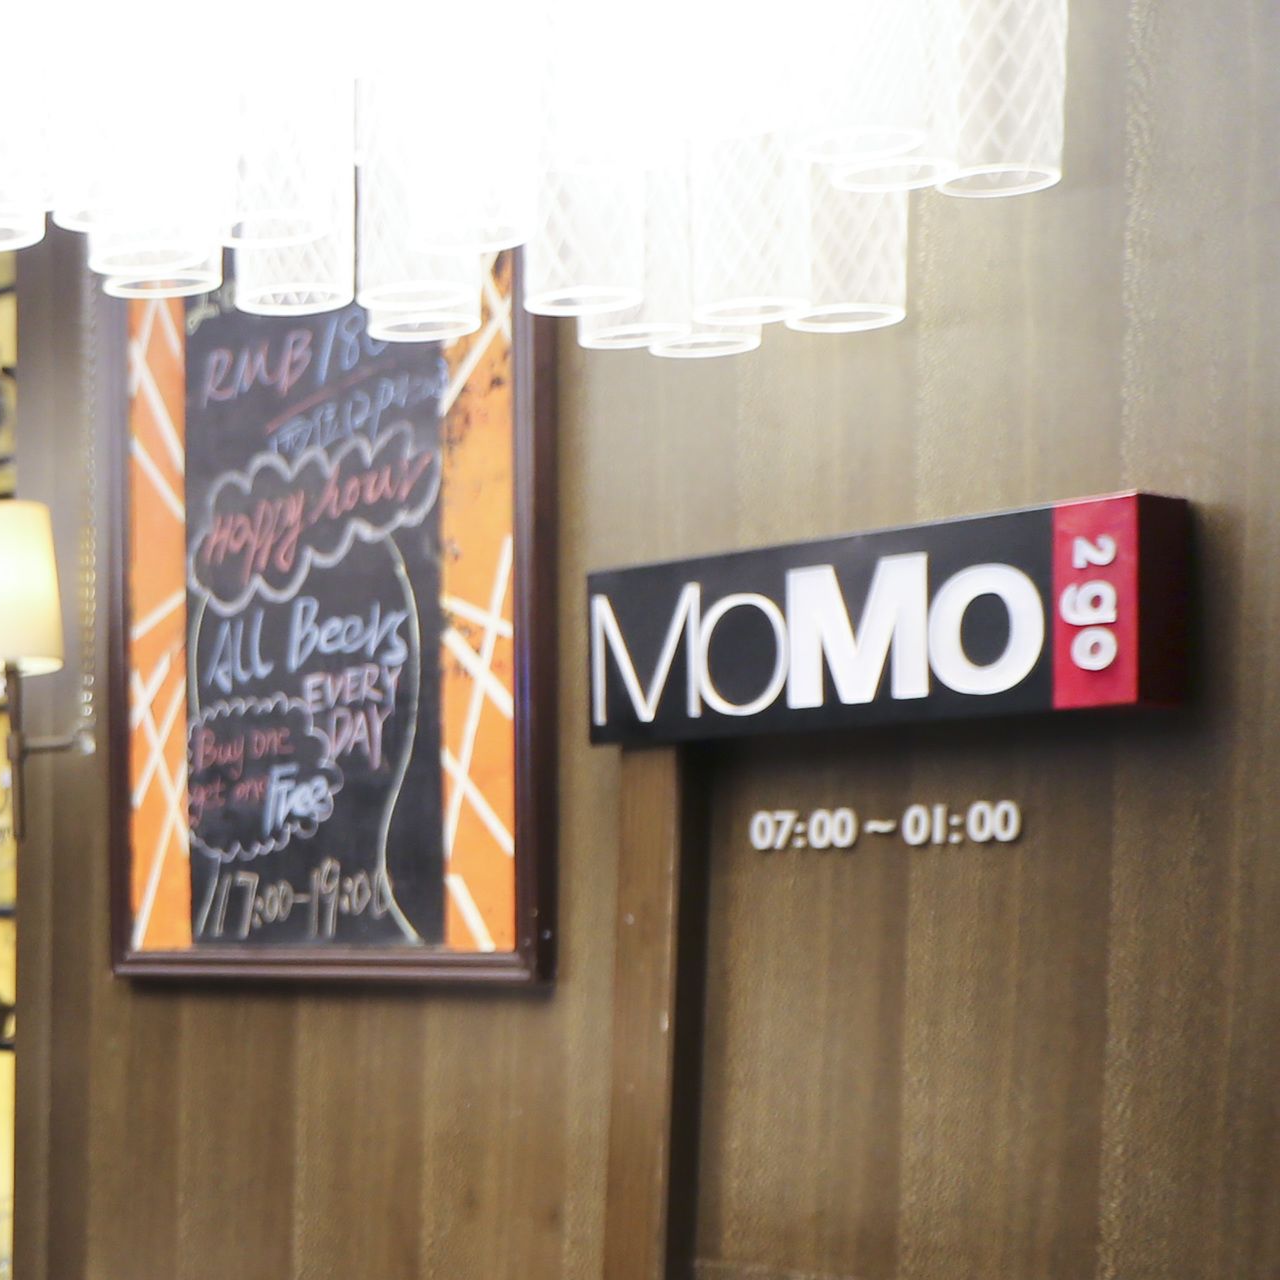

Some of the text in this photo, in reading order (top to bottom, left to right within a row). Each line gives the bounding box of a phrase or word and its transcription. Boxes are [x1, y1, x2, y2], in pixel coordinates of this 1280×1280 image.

[1059, 534, 1118, 672] 2go
[302, 662, 403, 713] EVERY
[327, 705, 395, 771] DAY
